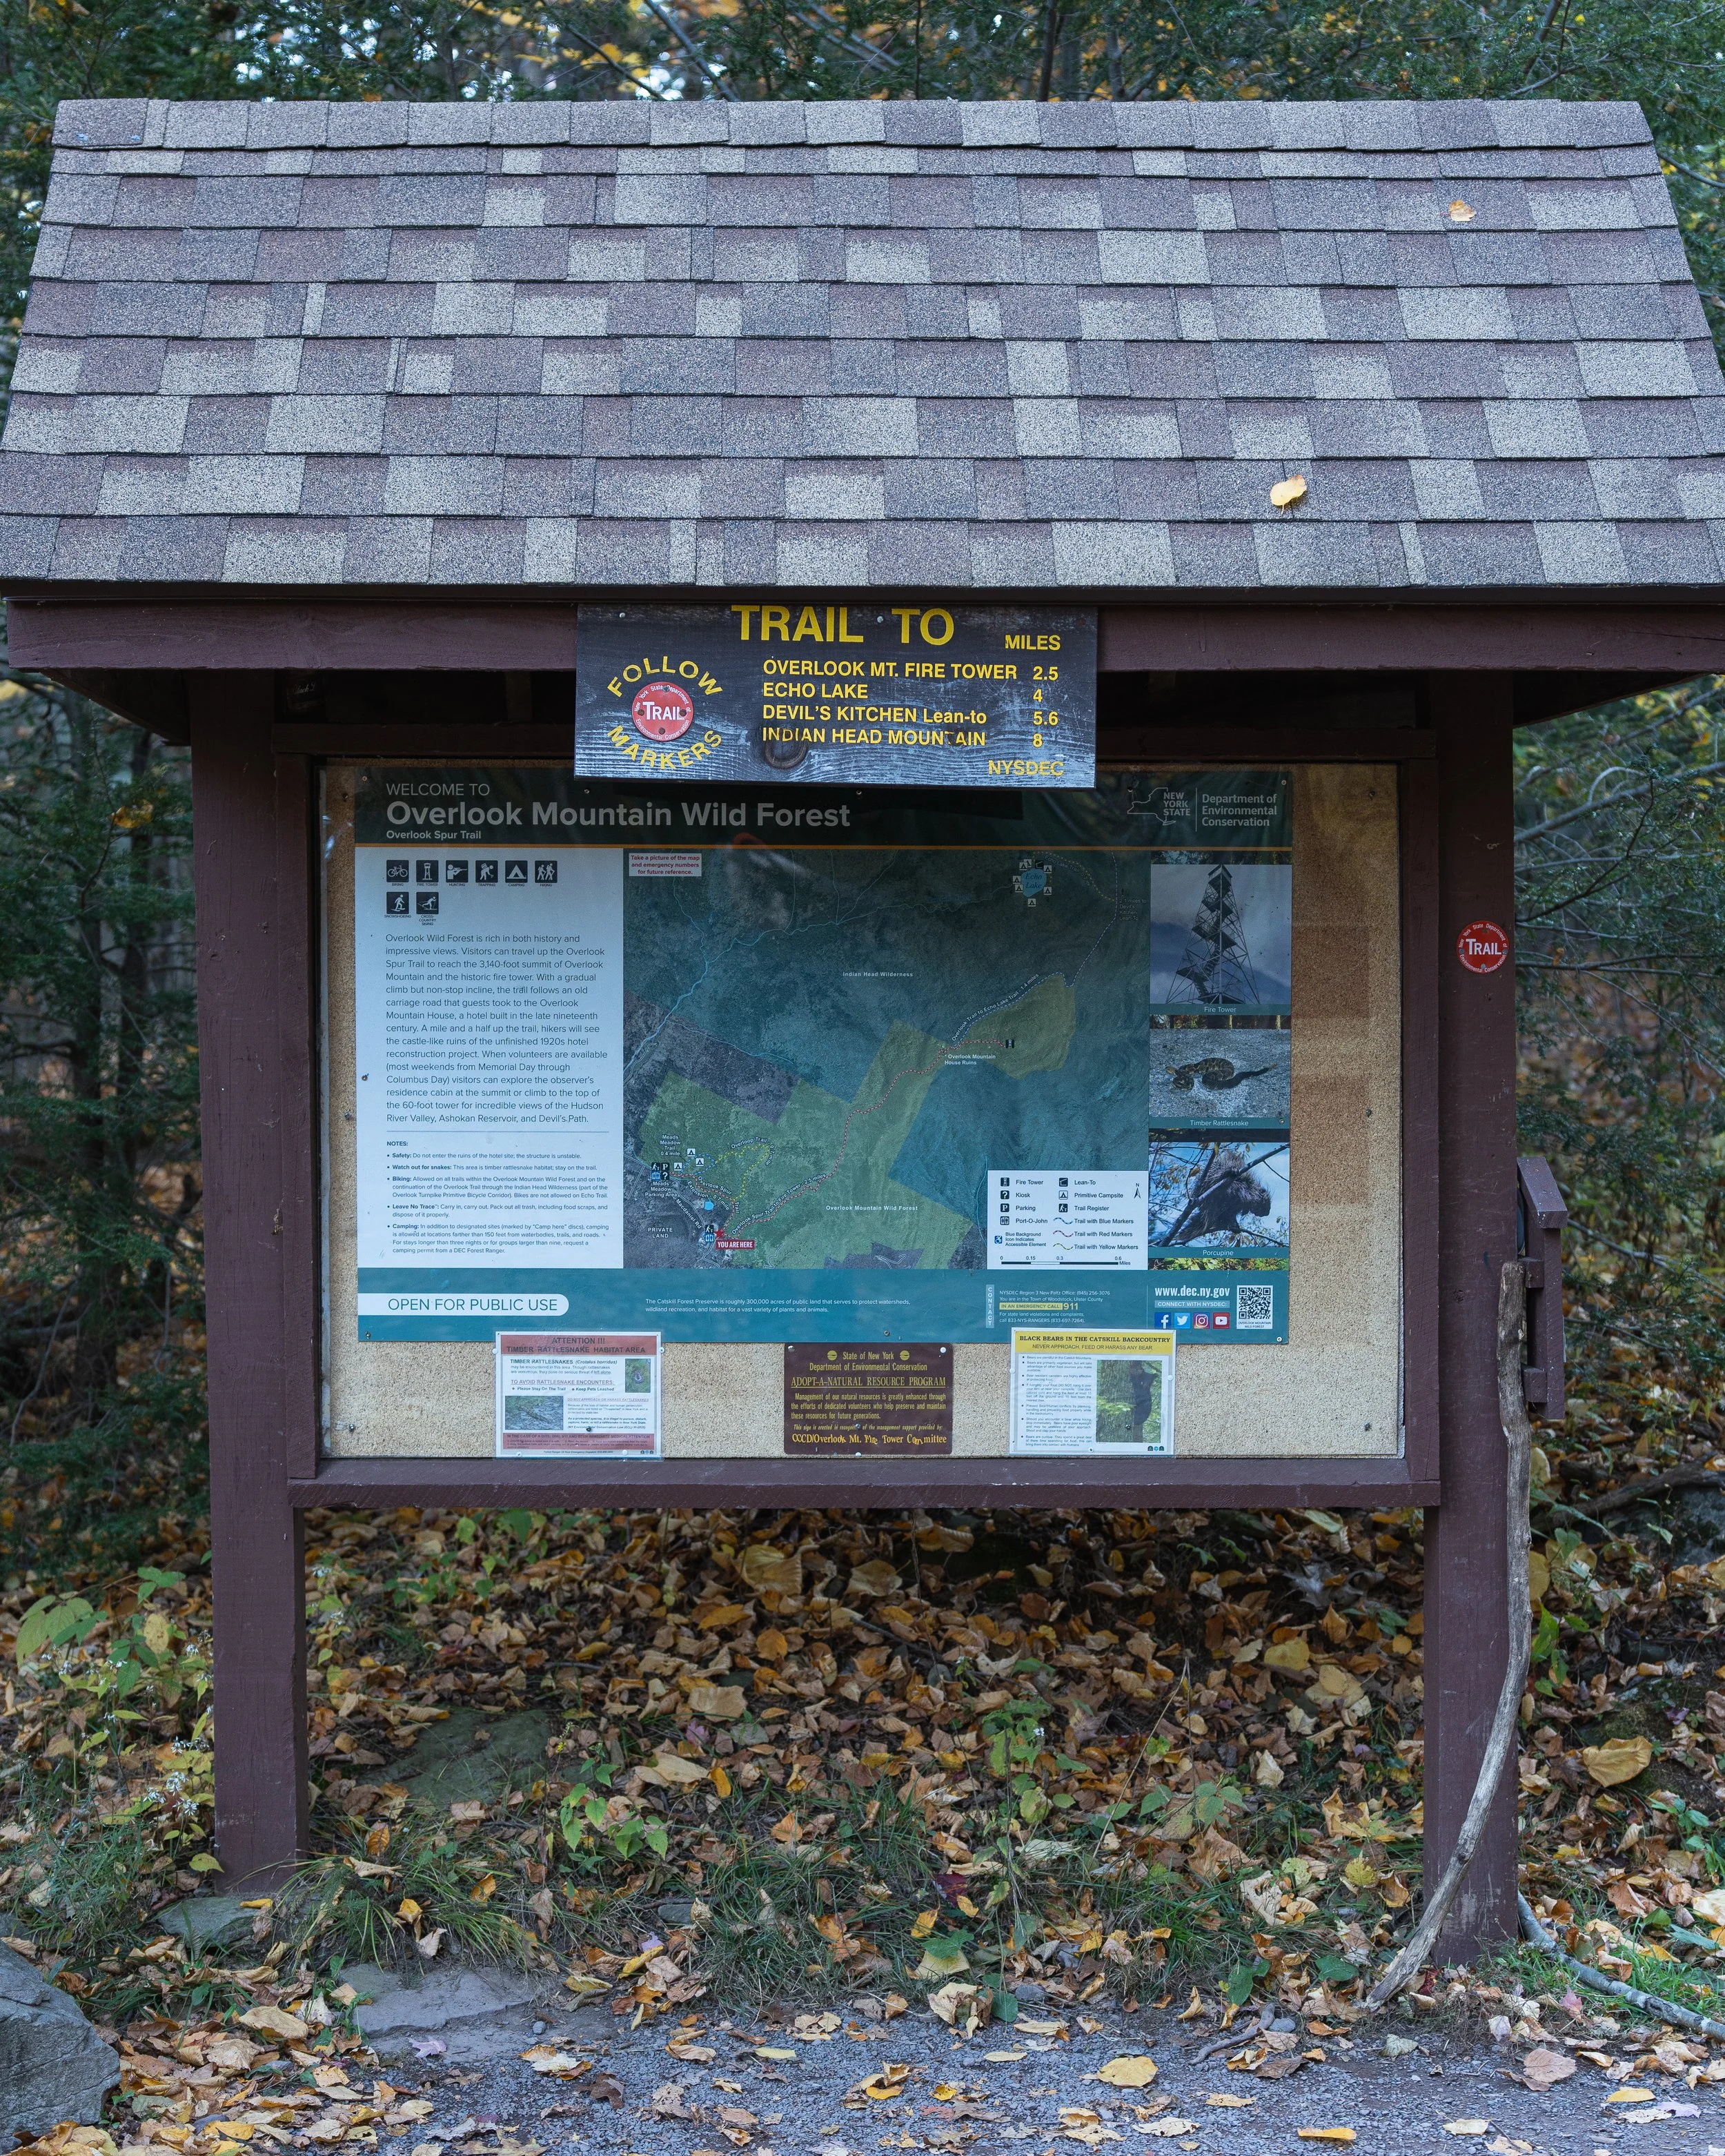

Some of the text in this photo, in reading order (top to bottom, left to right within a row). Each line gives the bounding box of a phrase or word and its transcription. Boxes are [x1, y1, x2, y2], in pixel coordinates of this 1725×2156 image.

[731, 604, 954, 646] TRAIL TO
[1005, 634, 1061, 651] MILES
[607, 655, 724, 698] FOLLOW
[762, 659, 1059, 681] OVERLOOK MT. FIRE TOWER 2.5
[763, 682, 868, 699] ECHO LAKE
[1032, 688, 1043, 702] 4
[837, 706, 917, 723] KITCHEN
[923, 708, 987, 725] Lean-to
[1032, 710, 1059, 726] 5.6
[762, 727, 1043, 749] INDIAN HEAD MOUNTAIN 8
[607, 724, 722, 770] MARKERS
[988, 759, 1064, 777] NYSDEC
[386, 783, 491, 796] WELCOME TO
[1163, 792, 1185, 800] NEW
[1163, 800, 1189, 809] YORK
[1202, 793, 1278, 806] Department of
[386, 800, 851, 827] Overlook Mountain Wild Forest
[1163, 809, 1191, 817] STATE
[1202, 805, 1277, 815] Environmental
[1201, 817, 1270, 827] Conservation
[386, 830, 482, 841] Overlook Spur Trail
[385, 933, 580, 945] Overlook Wild Forest is rich in both history and
[386, 947, 431, 957] impressive
[461, 947, 492, 956] Visitors
[511, 947, 535, 956] travel
[537, 949, 549, 957] up
[550, 947, 564, 956] the
[566, 947, 605, 956] Overlook
[1466, 938, 1502, 956] TRAIL
[1154, 1285, 1230, 1298] www.dec.ny.gov
[388, 1298, 558, 1311] OPEN FOR PUBLIC USE
[1063, 1302, 1078, 1310] 911
[537, 1345, 590, 1354] RATTLESNAKE
[842, 1352, 896, 1361] State of New York
[809, 1363, 928, 1372] Department of Environmental Conservation
[867, 1376, 905, 1387] RESOURCE
[908, 1376, 947, 1387] PROGRAM
